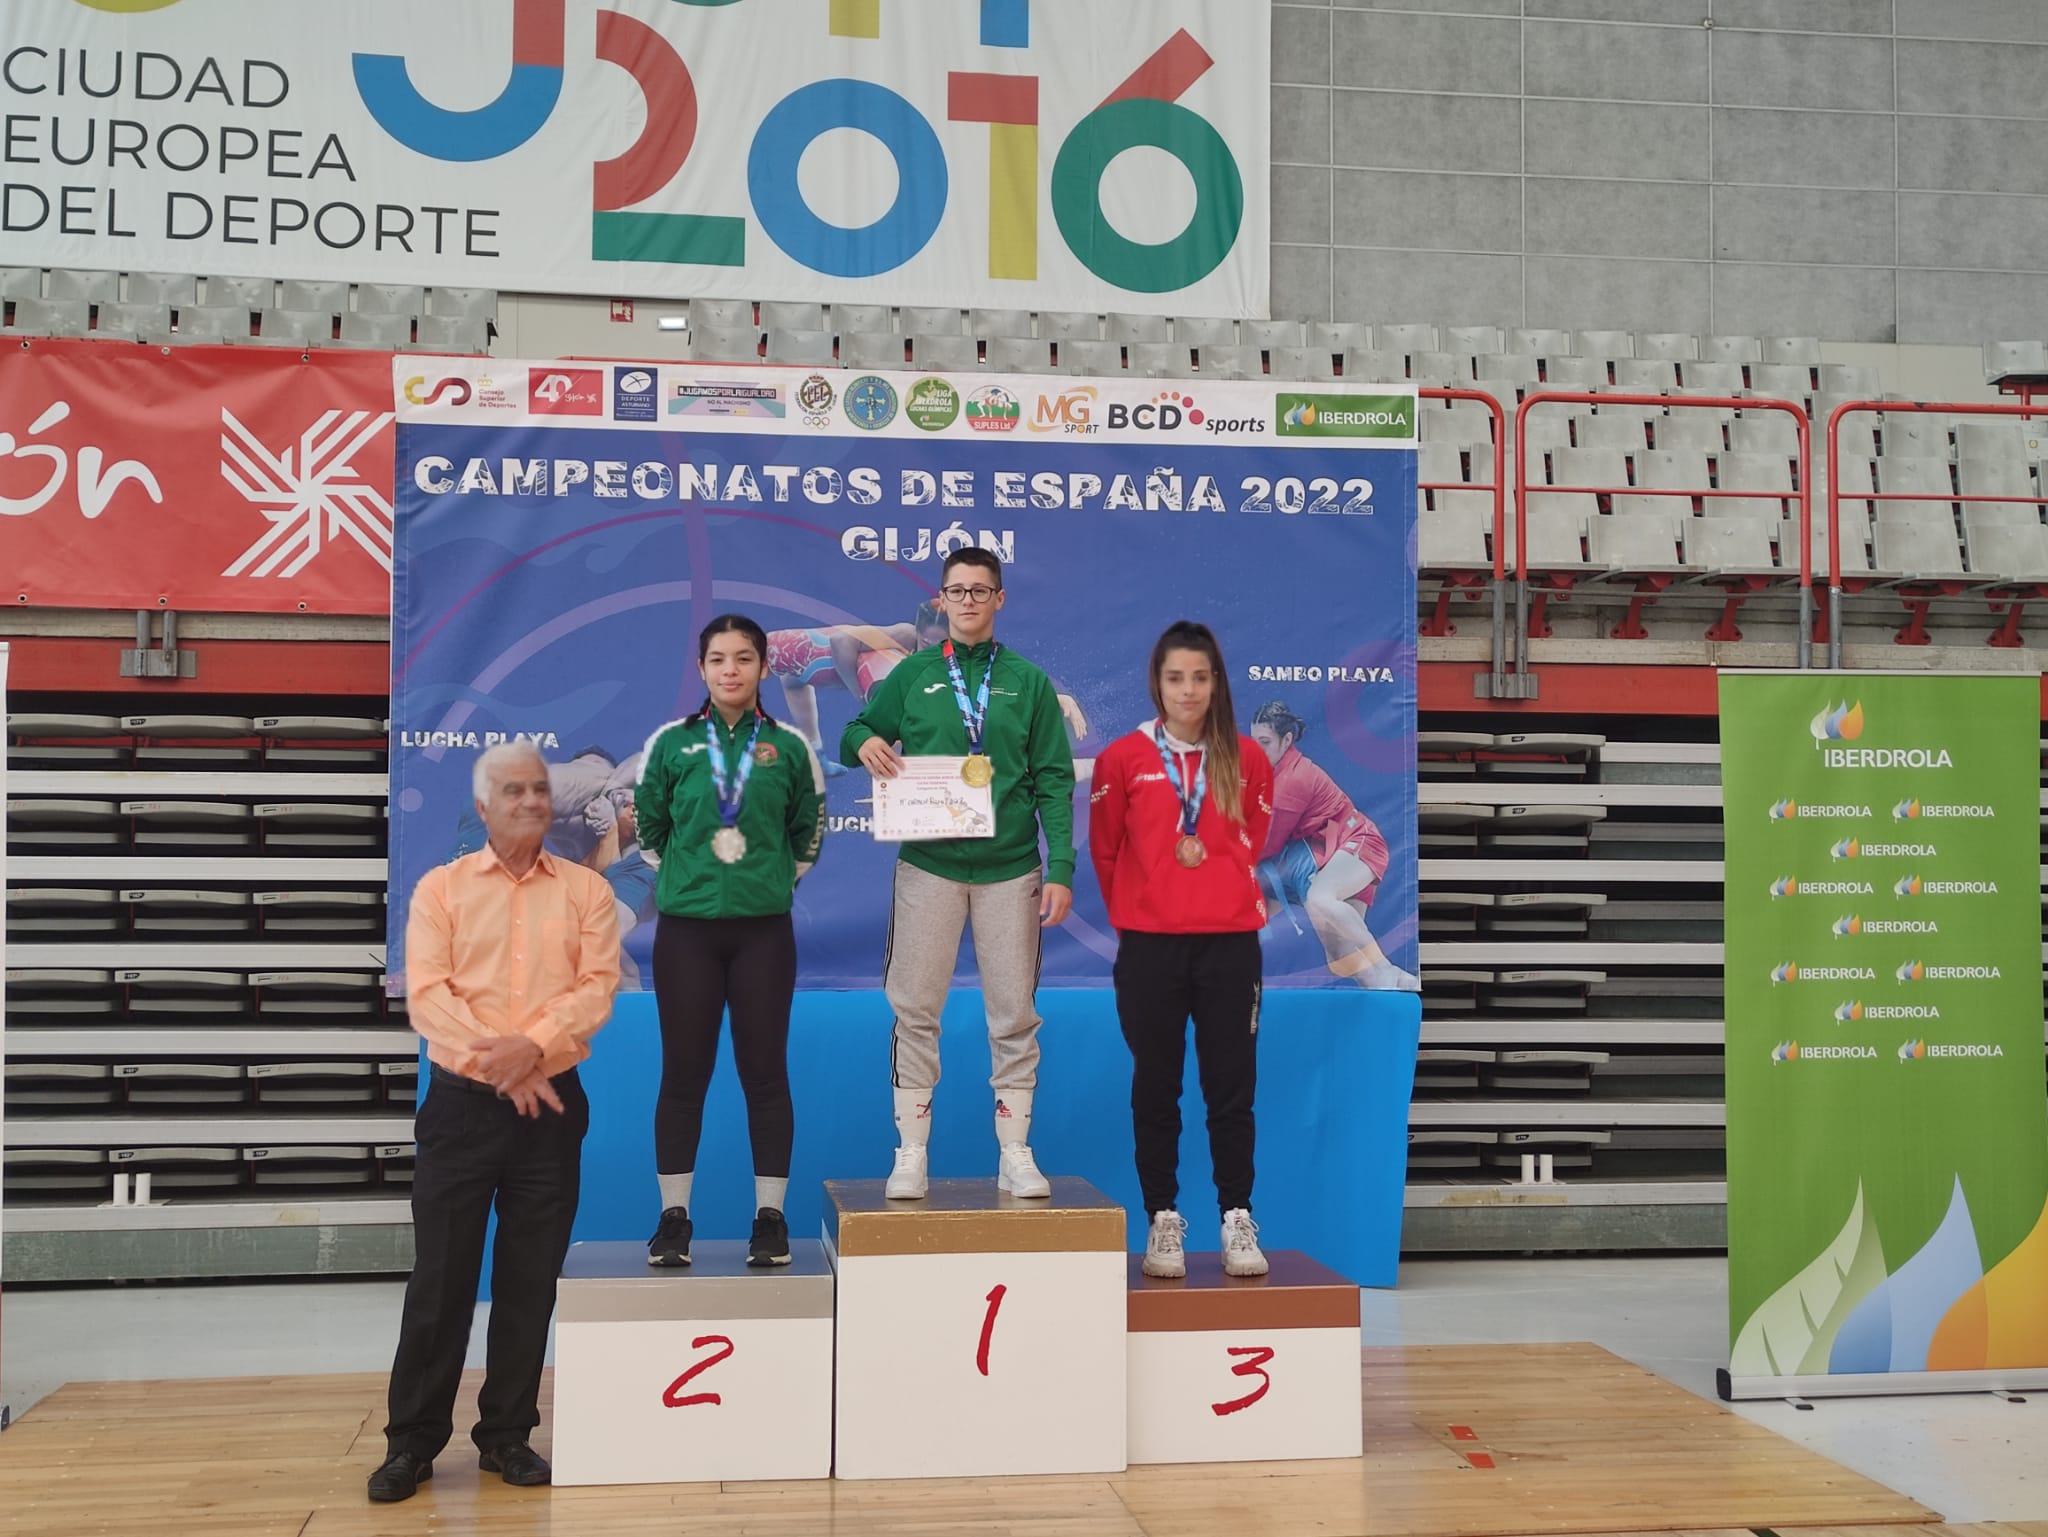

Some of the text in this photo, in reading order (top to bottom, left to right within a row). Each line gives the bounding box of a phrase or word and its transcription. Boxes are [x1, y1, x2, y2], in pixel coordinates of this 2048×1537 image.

[3, 46, 289, 108] CIUDAD
[4, 114, 356, 182] EUROPEA
[593, 9, 1244, 293] 2016
[2, 183, 501, 258] DEL DEPORTE
[1038, 395, 1090, 424] MG
[974, 421, 999, 430] SUPLES
[1108, 404, 1266, 435] BCD sports
[1319, 411, 1407, 426] IBERDROLA
[1064, 424, 1100, 434] SPORT
[414, 455, 1375, 516] CAMPEONATOS DE ESPAÑA 2022
[840, 521, 1015, 564] GIJÓN
[1248, 665, 1395, 683] SAMBO PLAYA
[401, 731, 480, 749] LUCHA
[1824, 749, 1952, 768] IBERDROLA
[1798, 805, 1872, 817] IBERDROLA
[1922, 805, 1995, 817] IBERDROLA
[1861, 844, 1937, 856] IBERDROLA
[1798, 882, 1874, 894] IBERDROLA
[1923, 881, 1998, 894] IBERDROLA
[1862, 921, 1938, 933] IBERDROLA
[1799, 967, 1876, 980] IBERDROLA
[1925, 966, 2001, 979] IBERDROLA
[1865, 1006, 1939, 1018] IBERDROLA
[1800, 1046, 1877, 1058] IBERDROLA
[1927, 1045, 2003, 1057] IBERDROLA
[975, 1283, 1007, 1377] 1
[662, 1335, 735, 1409] 2
[1211, 1346, 1275, 1417] 3
